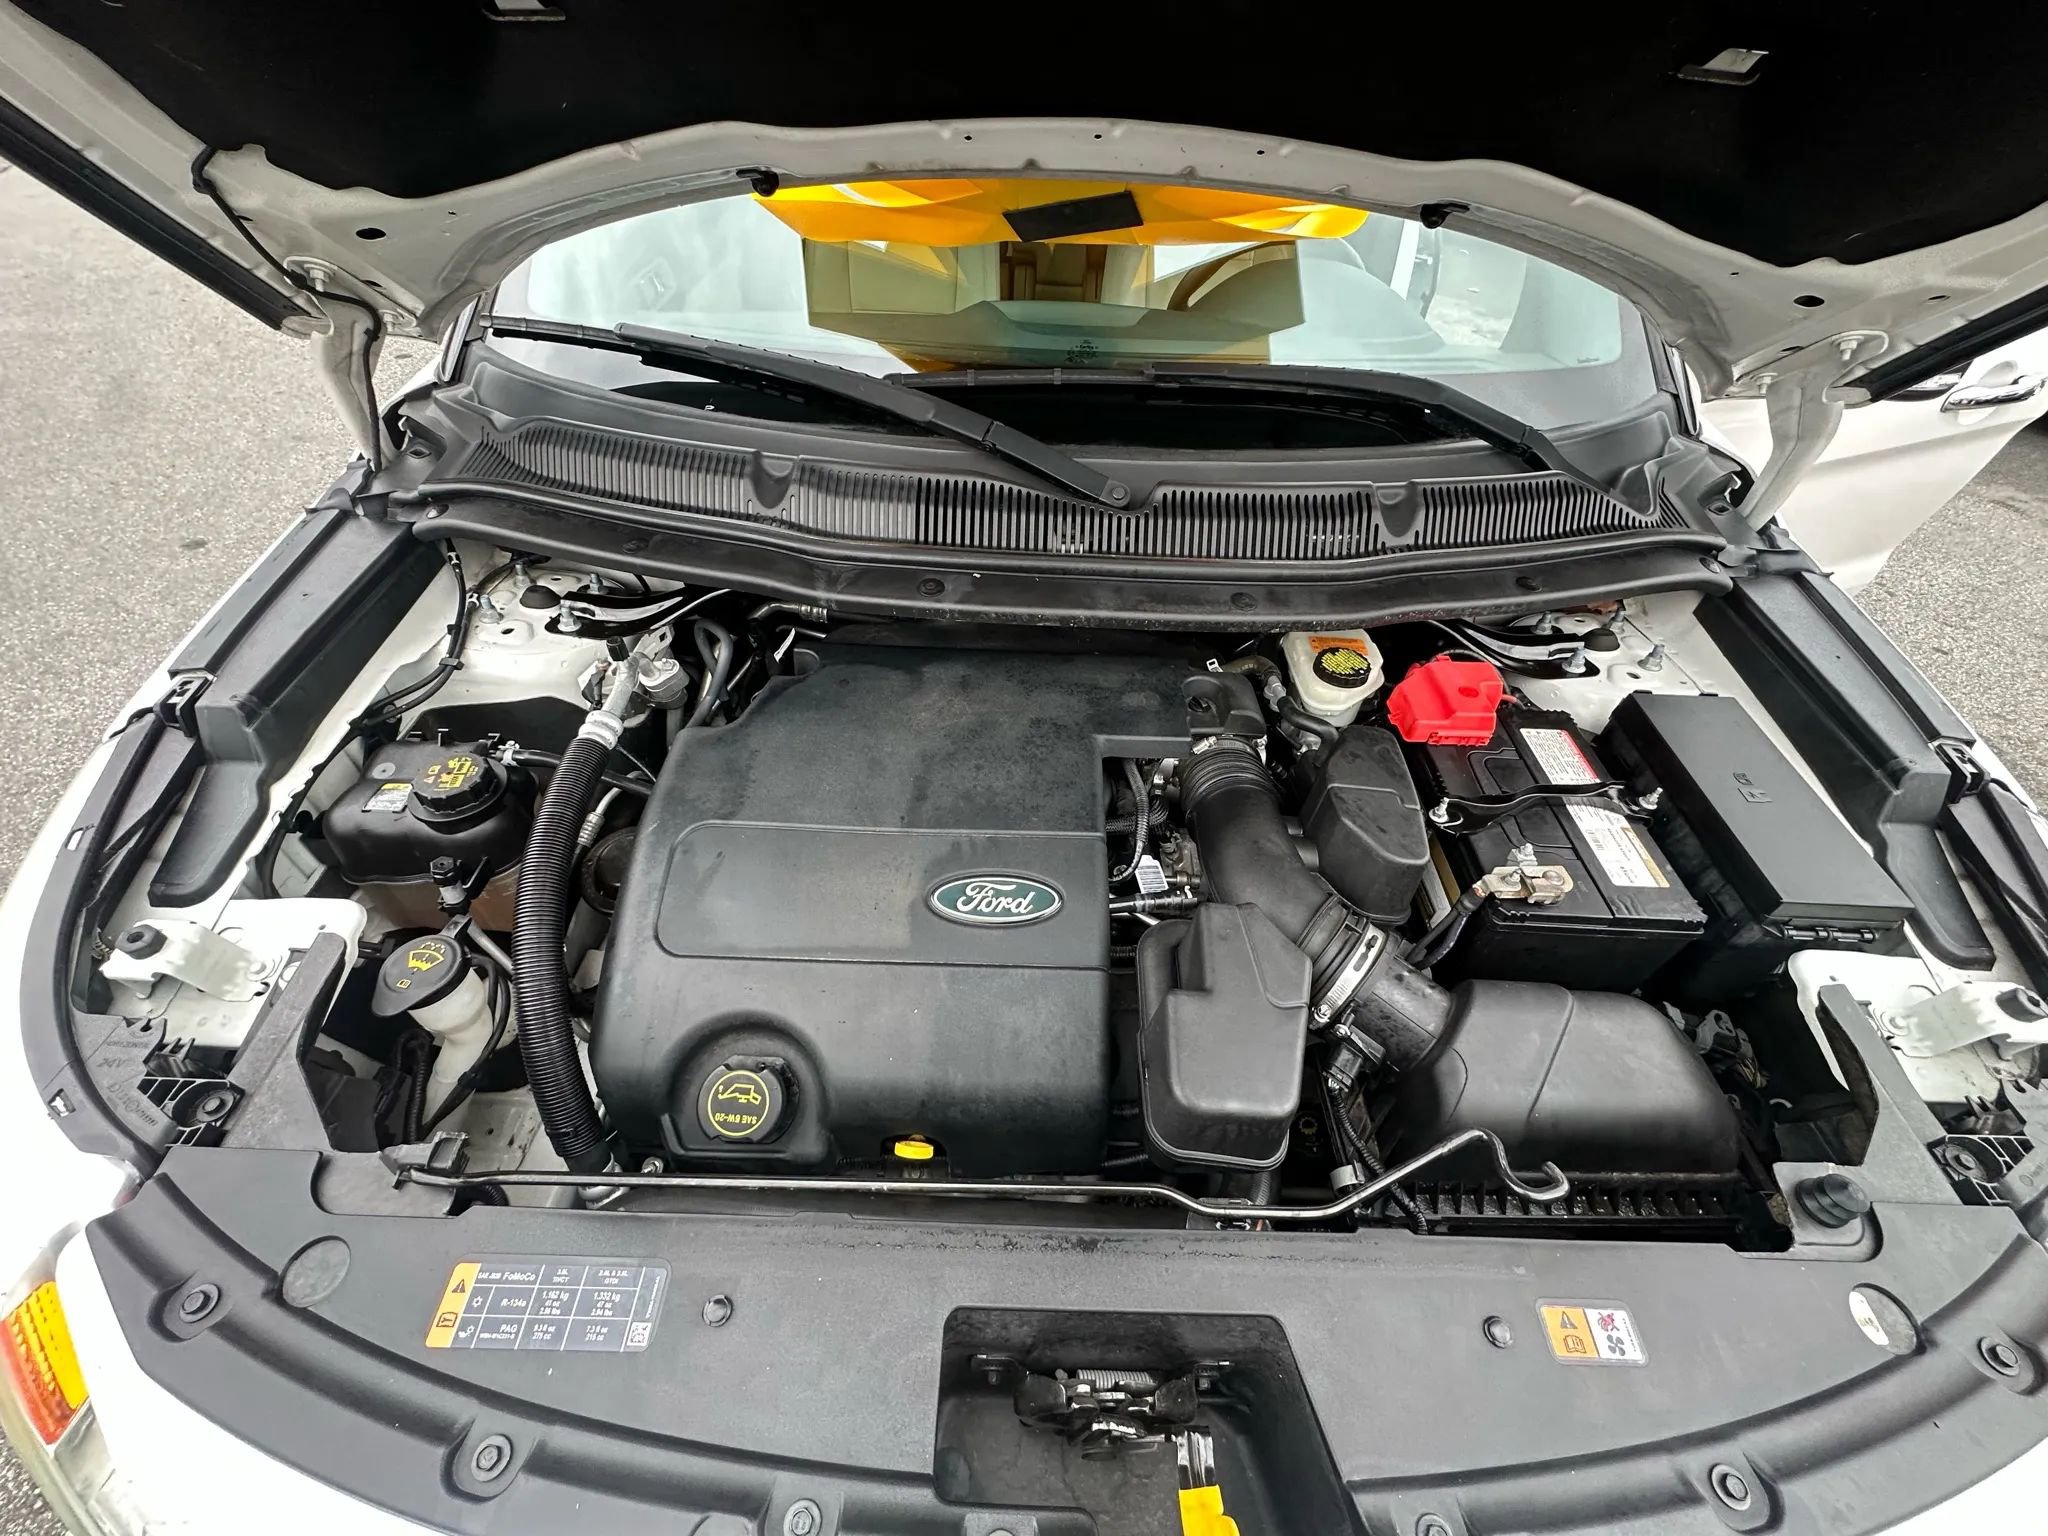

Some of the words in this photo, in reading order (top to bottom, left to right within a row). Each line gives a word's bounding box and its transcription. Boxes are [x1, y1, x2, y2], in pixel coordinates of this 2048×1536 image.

[956, 881, 1036, 914] Ford
[741, 1115, 758, 1124] SAE
[503, 1271, 536, 1281] FoMoCo
[560, 1290, 569, 1302] kg
[611, 1291, 620, 1303] kg
[501, 1298, 527, 1307] R-134a
[500, 1324, 517, 1332] PAG
